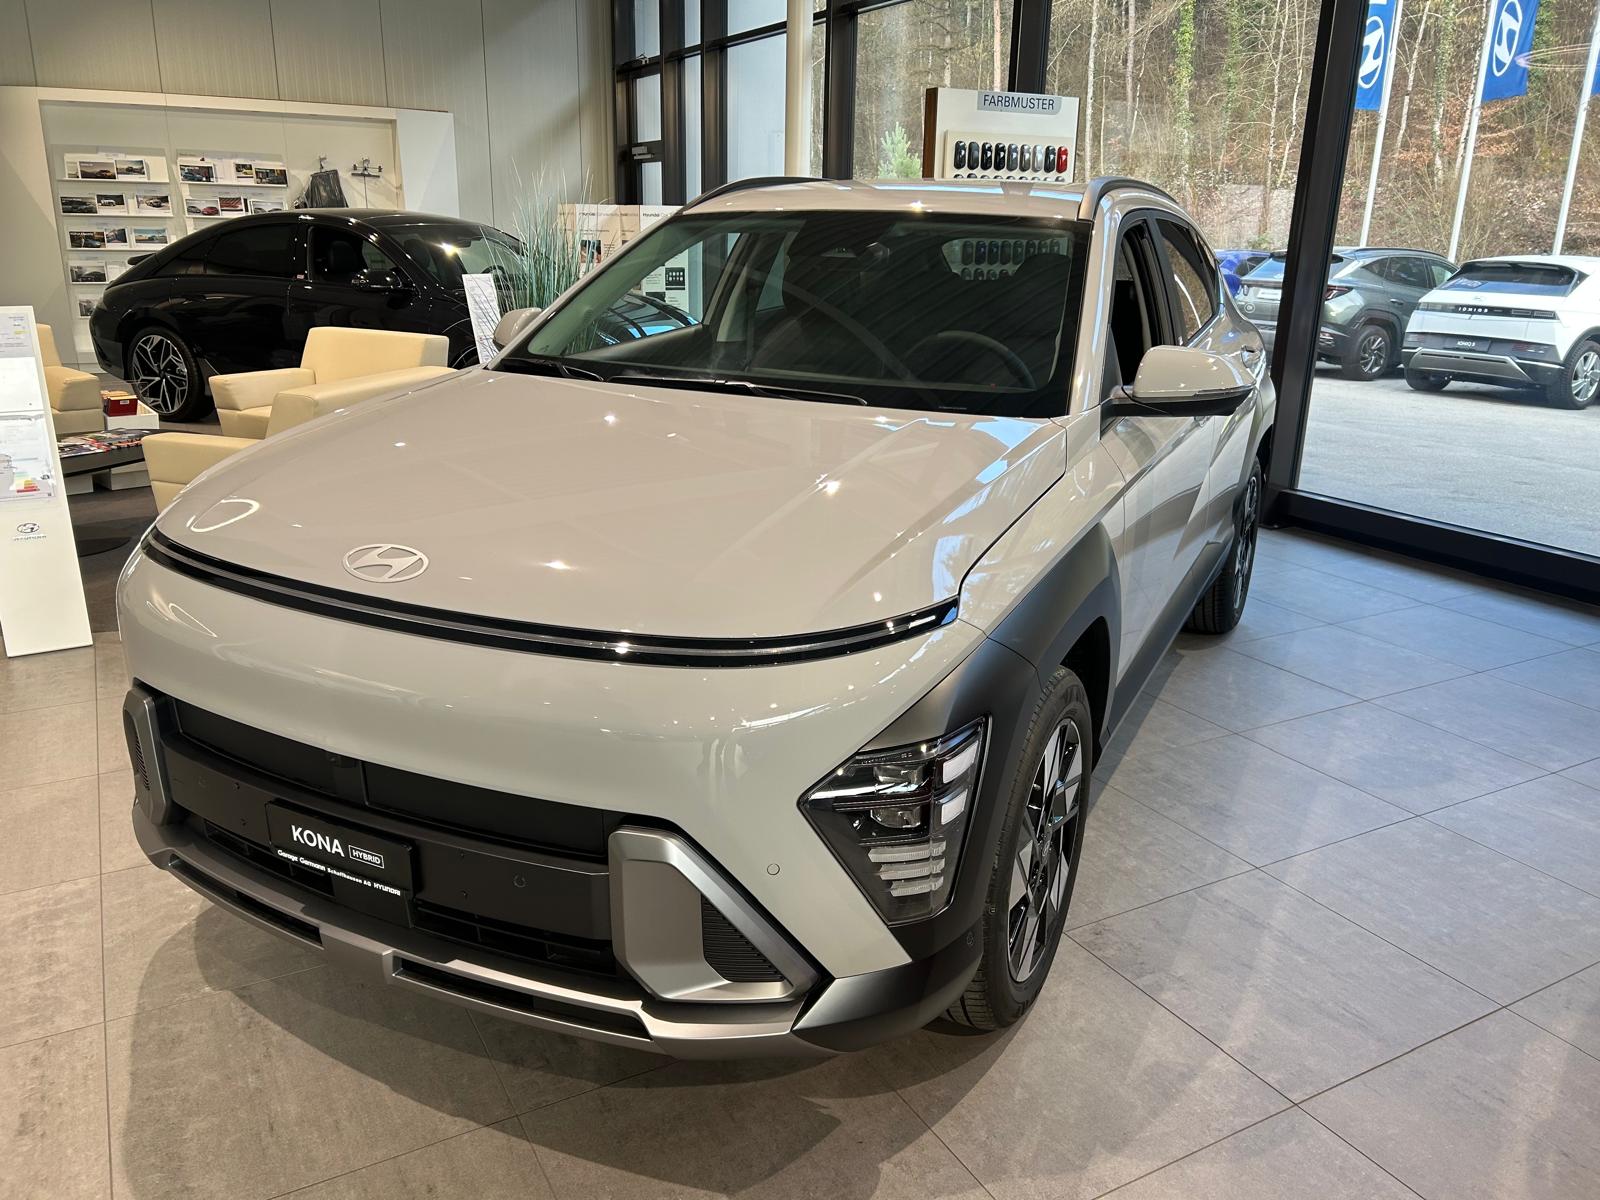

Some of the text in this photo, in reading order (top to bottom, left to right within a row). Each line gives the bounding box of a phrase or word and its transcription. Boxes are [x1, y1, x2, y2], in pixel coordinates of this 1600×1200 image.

[983, 94, 1055, 110] FARBMUSTER
[291, 825, 381, 864] KONA HYBRID
[277, 849, 298, 862] Garage
[327, 867, 363, 884] Schaffhausen
[363, 879, 372, 887] AG
[373, 882, 401, 896] HYUNDAI
